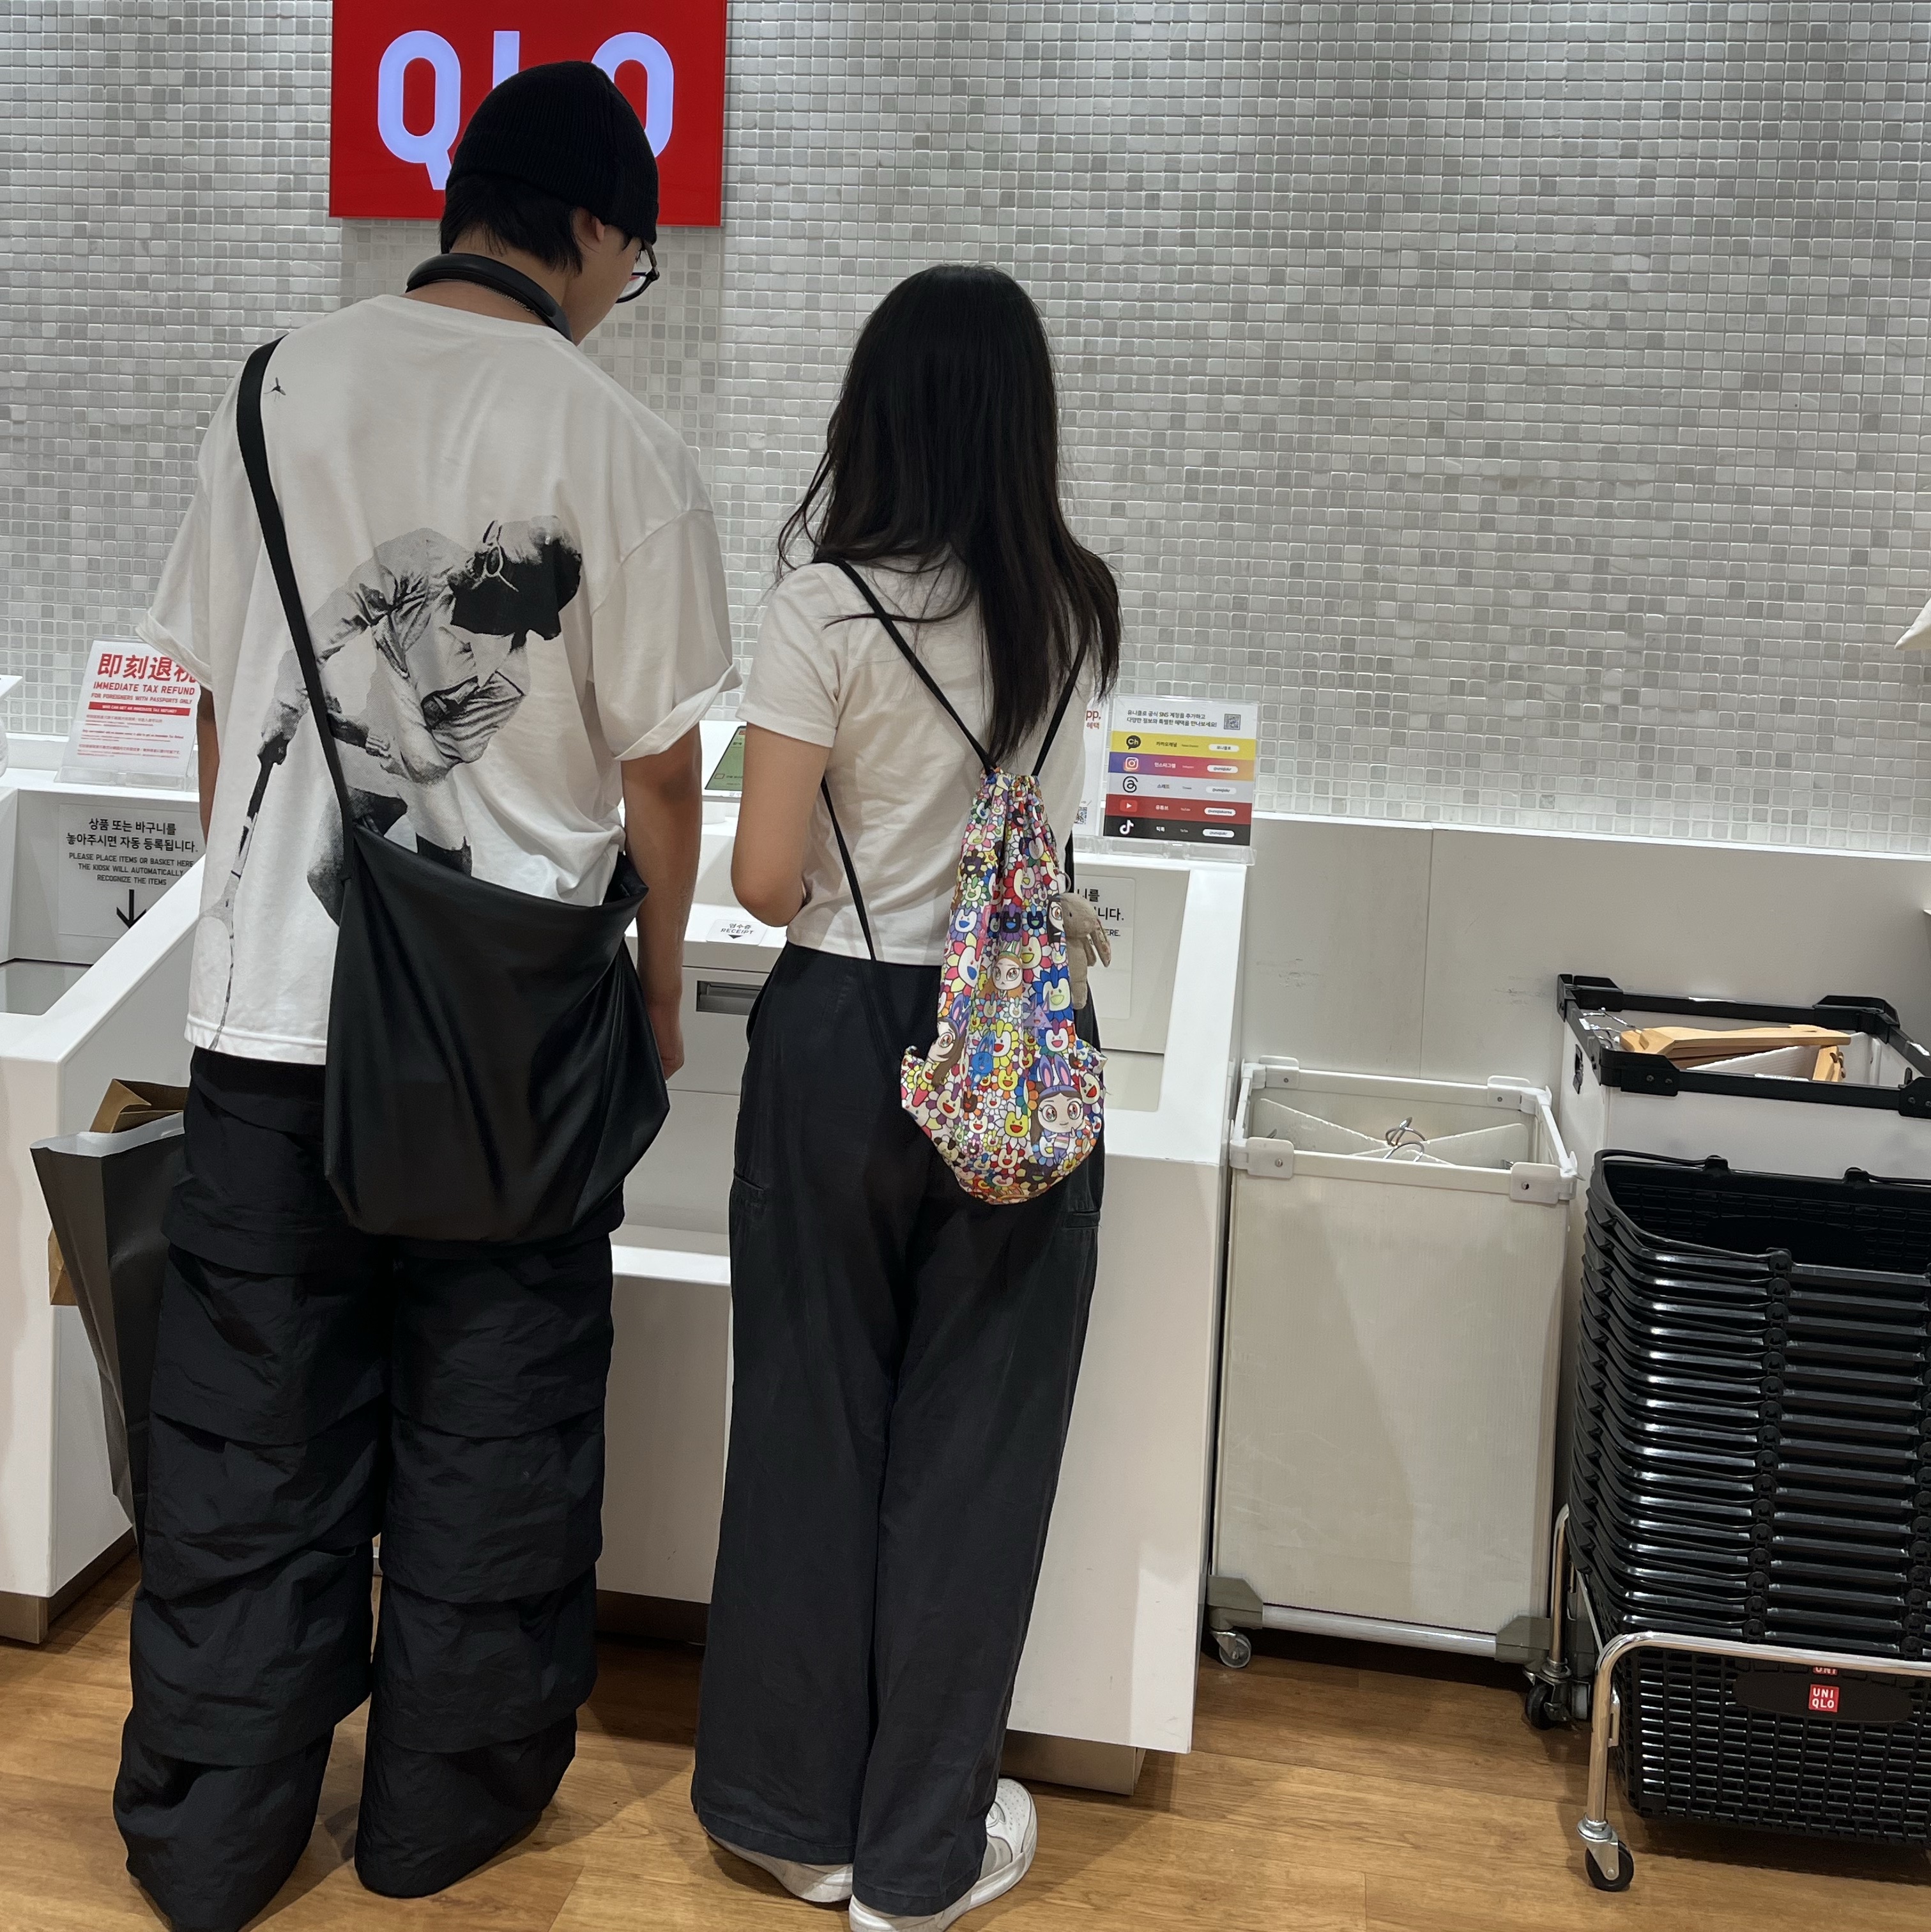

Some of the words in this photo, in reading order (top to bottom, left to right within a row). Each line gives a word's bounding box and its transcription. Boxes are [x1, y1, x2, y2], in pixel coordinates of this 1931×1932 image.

[93, 681, 139, 692] IMMEDIATE
[142, 684, 158, 693] TAX
[161, 686, 195, 695] REFUND
[88, 818, 109, 831] 상품
[111, 820, 132, 832] 또는
[135, 821, 176, 836] 바구니를
[66, 832, 117, 847] 놓아주시면
[120, 836, 141, 849] 자동
[143, 838, 199, 853] 등록됩니다.
[96, 854, 117, 862] PLACE
[150, 858, 175, 866] BASKET
[131, 866, 184, 877] AUTOMATICALLY
[97, 874, 132, 884] RECOGNIZE
[148, 877, 167, 885] ITEMS
[1094, 906, 1124, 921] 니다.
[1813, 1687, 1833, 1698] UNI
[1812, 1698, 1835, 1708] QLO
